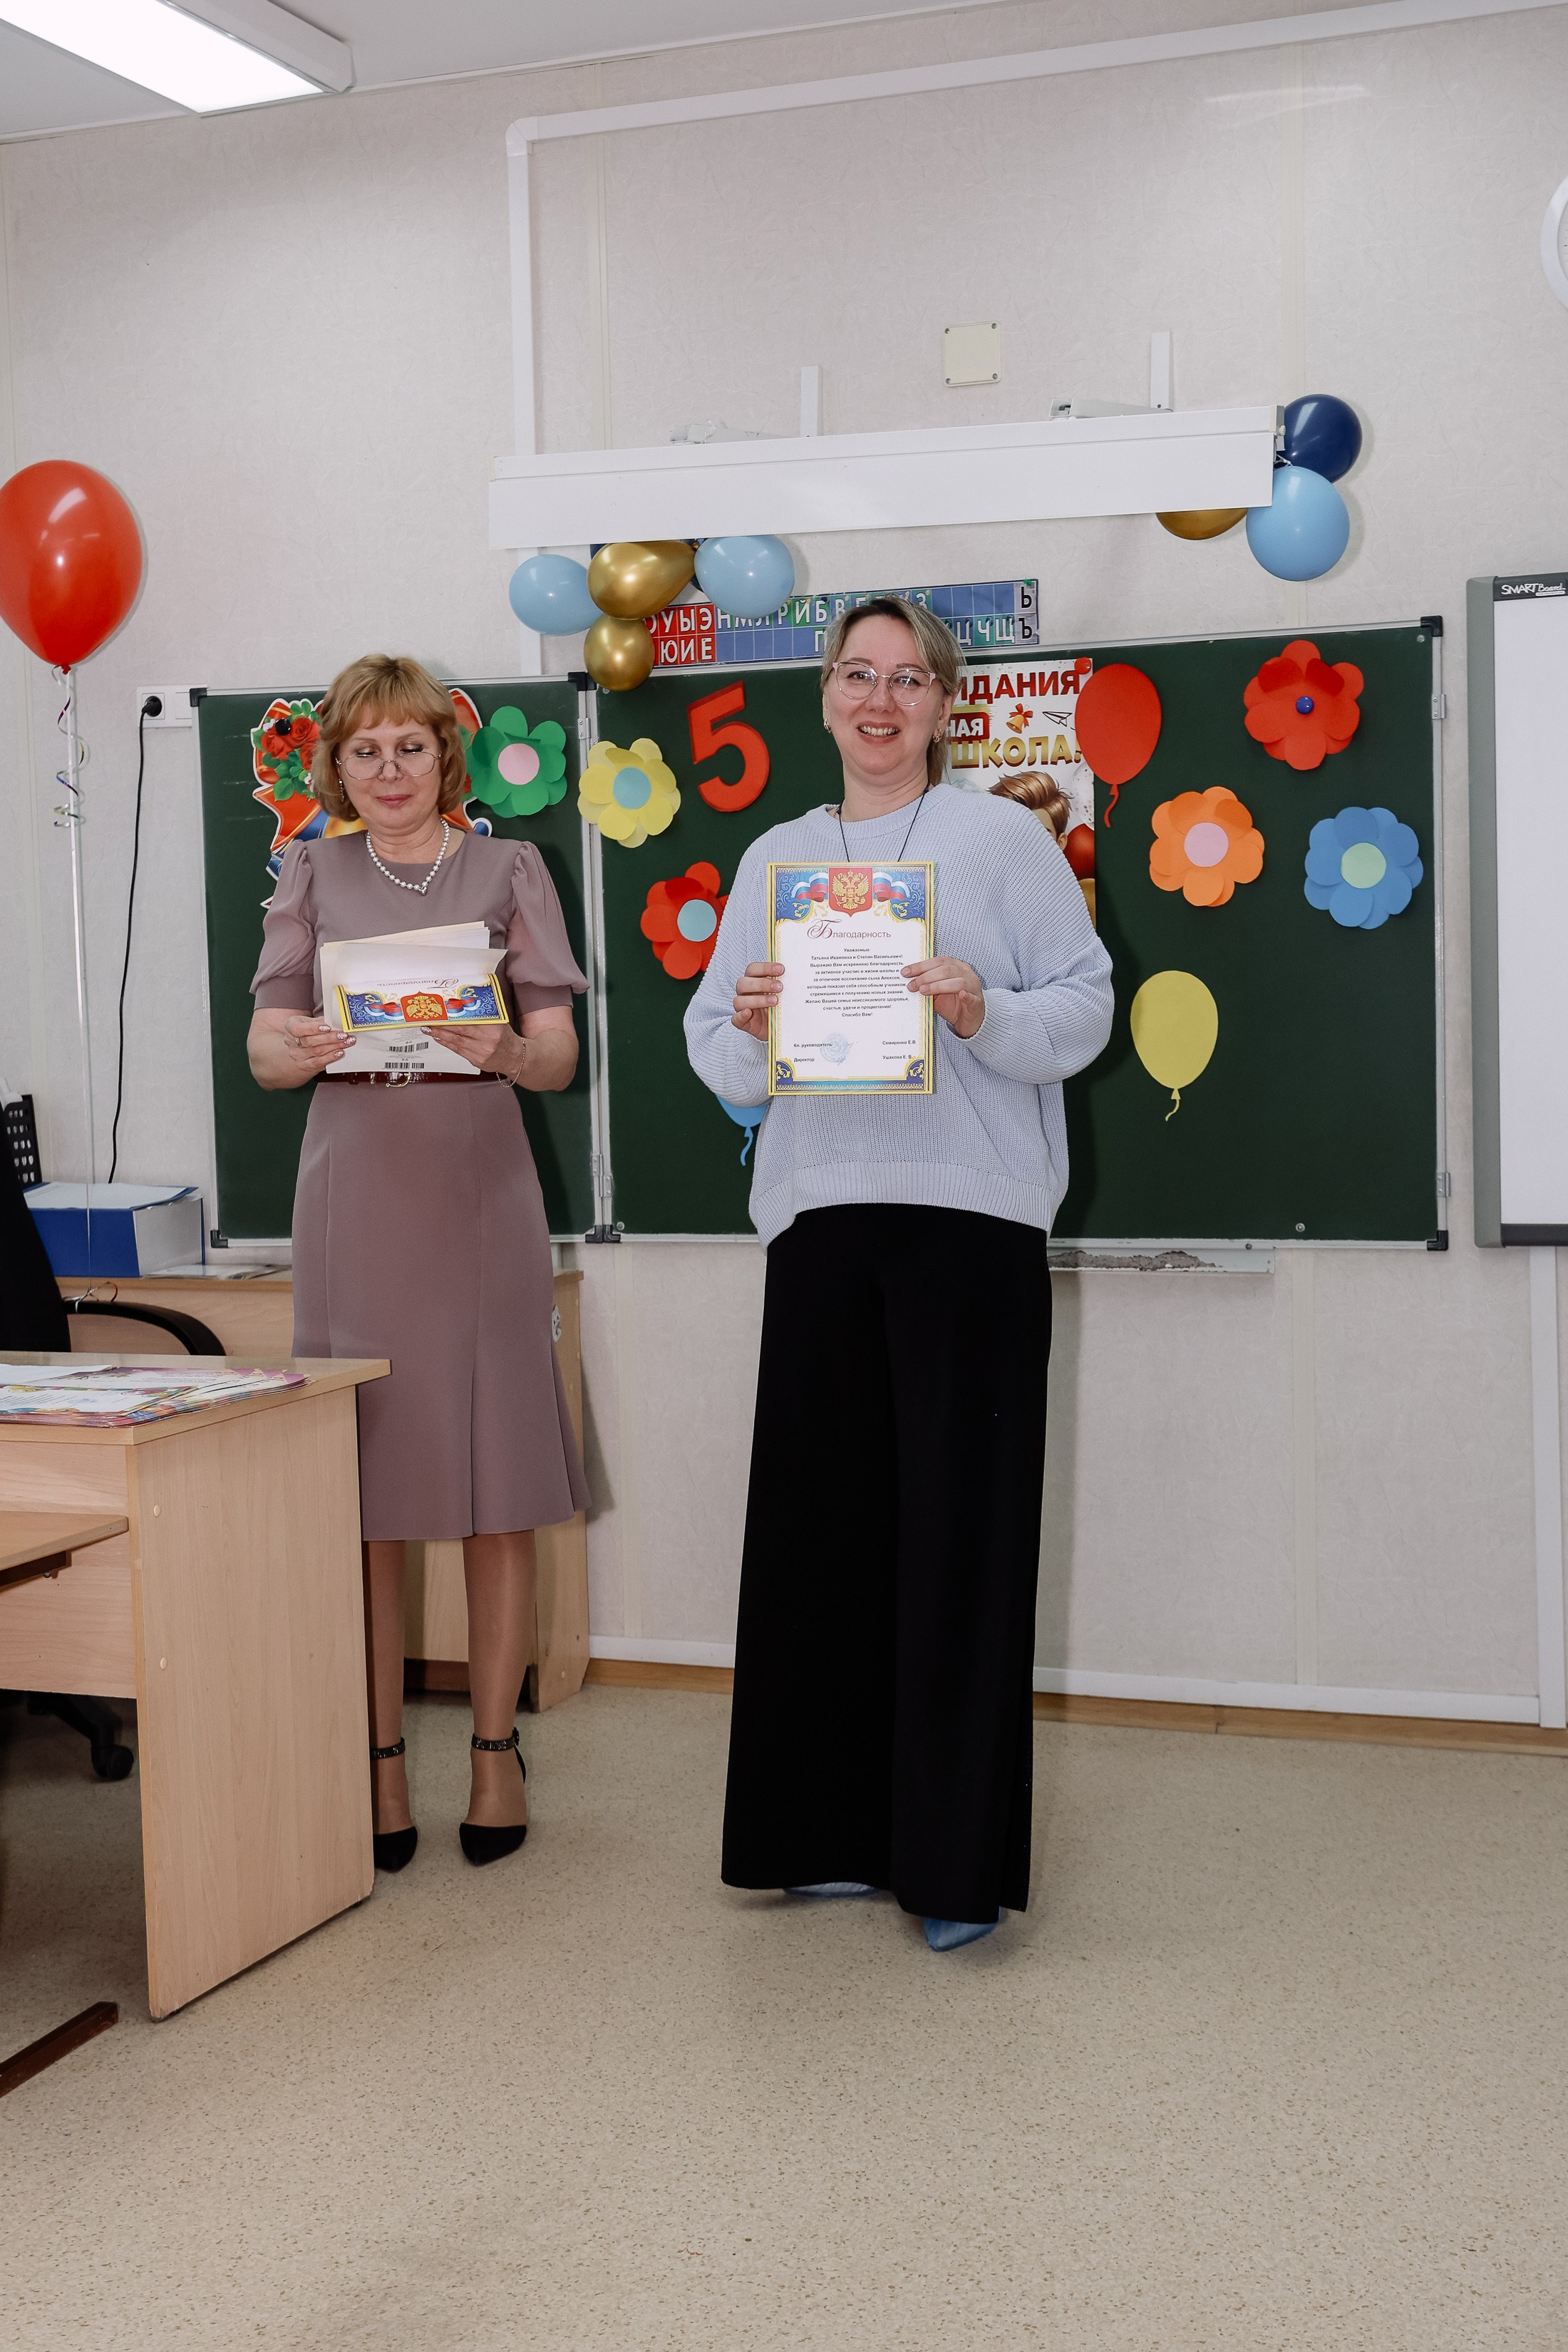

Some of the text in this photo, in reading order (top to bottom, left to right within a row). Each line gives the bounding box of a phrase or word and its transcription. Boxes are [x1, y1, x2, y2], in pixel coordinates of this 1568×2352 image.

[1501, 583, 1539, 594] SMART
[686, 679, 770, 813] 5
[807, 919, 892, 939] Благодарность
